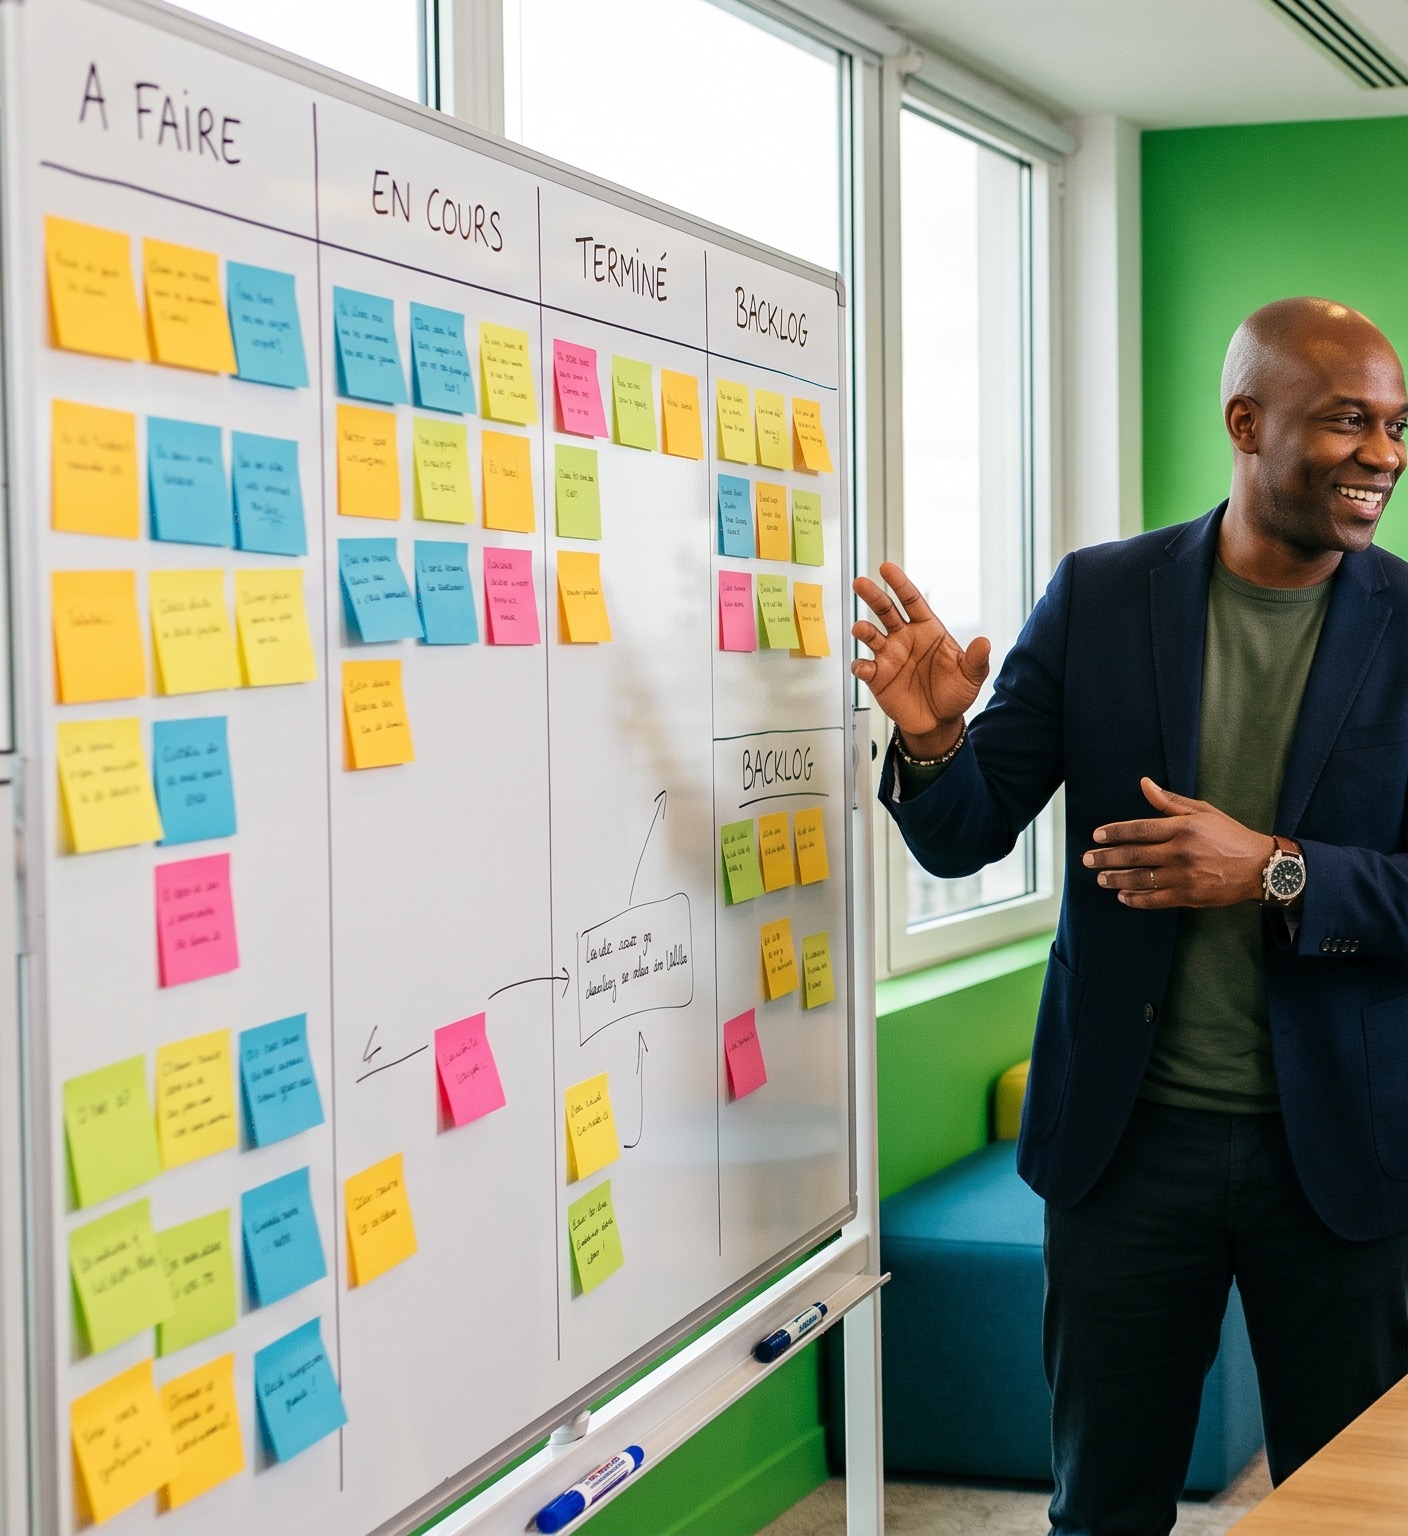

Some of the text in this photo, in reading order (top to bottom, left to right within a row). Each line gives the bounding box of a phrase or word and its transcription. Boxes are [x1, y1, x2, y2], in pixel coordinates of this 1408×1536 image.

[79, 61, 108, 132] A
[372, 169, 504, 253] EN COURS
[735, 286, 809, 348] BACKLOG
[742, 746, 815, 791] BACKLOG
